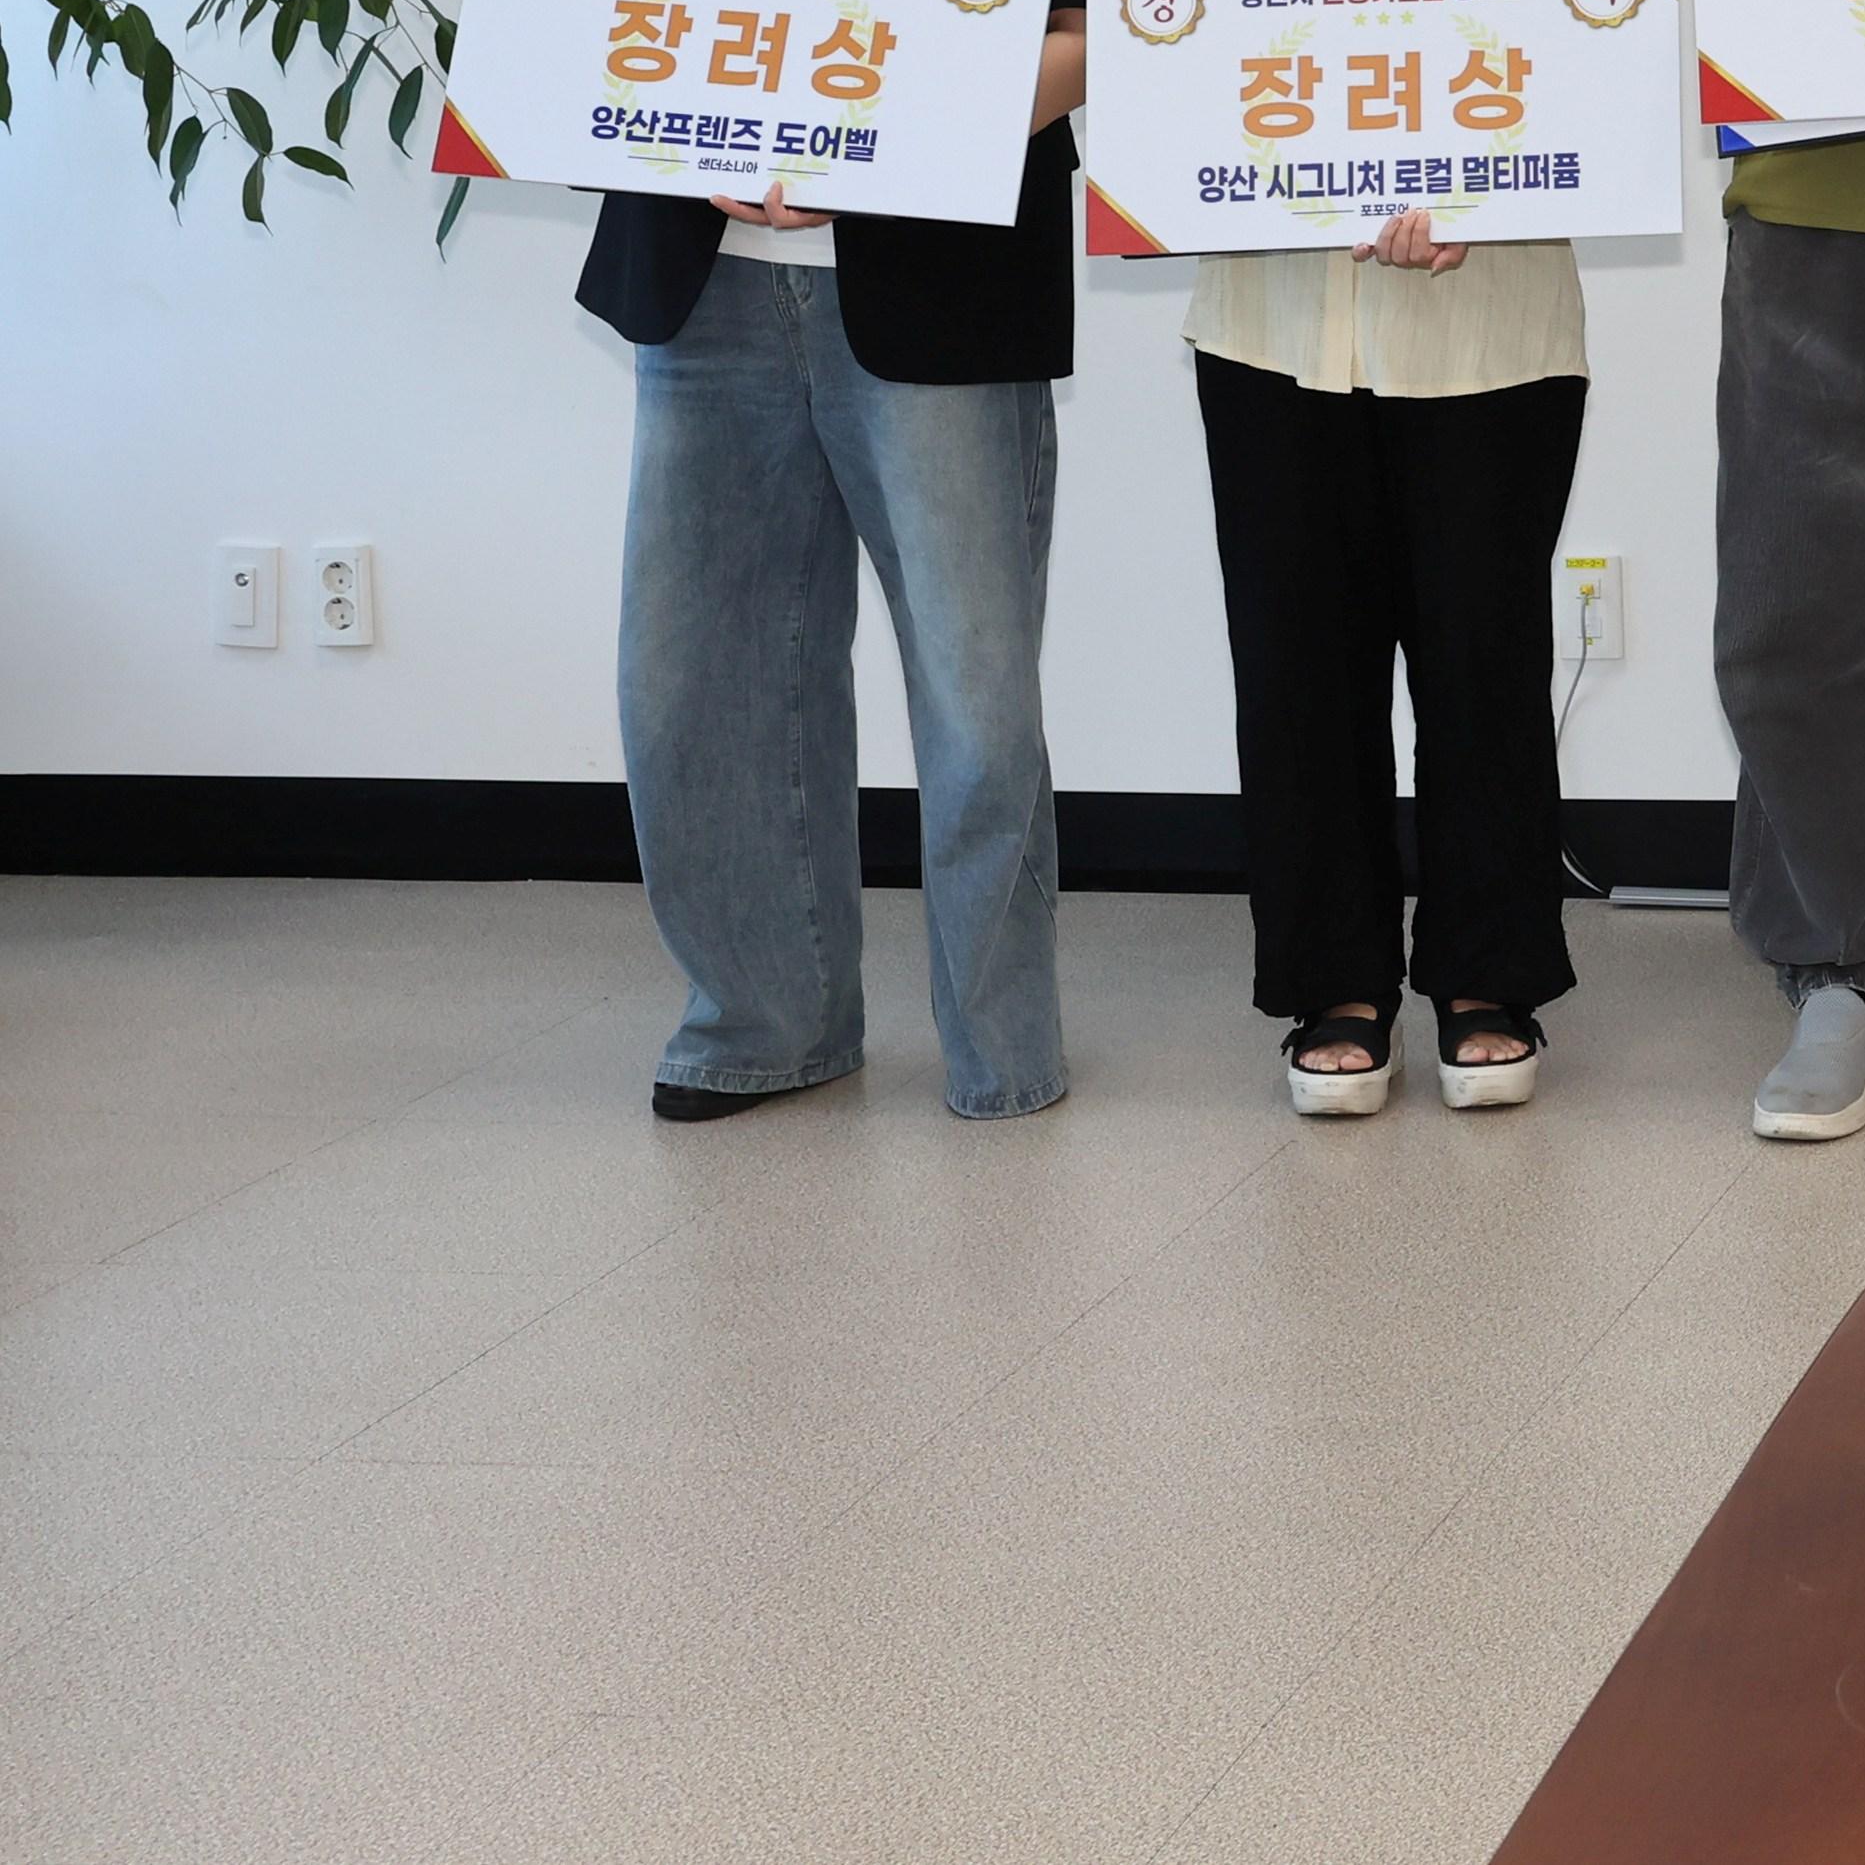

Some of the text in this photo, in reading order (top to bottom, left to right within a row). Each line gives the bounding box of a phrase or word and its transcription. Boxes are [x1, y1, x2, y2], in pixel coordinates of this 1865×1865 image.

[591, 106, 878, 162] 양산프렌즈 도어벨
[1198, 153, 1580, 203] 양산 시그니처 로컬 멀티퍼퓸
